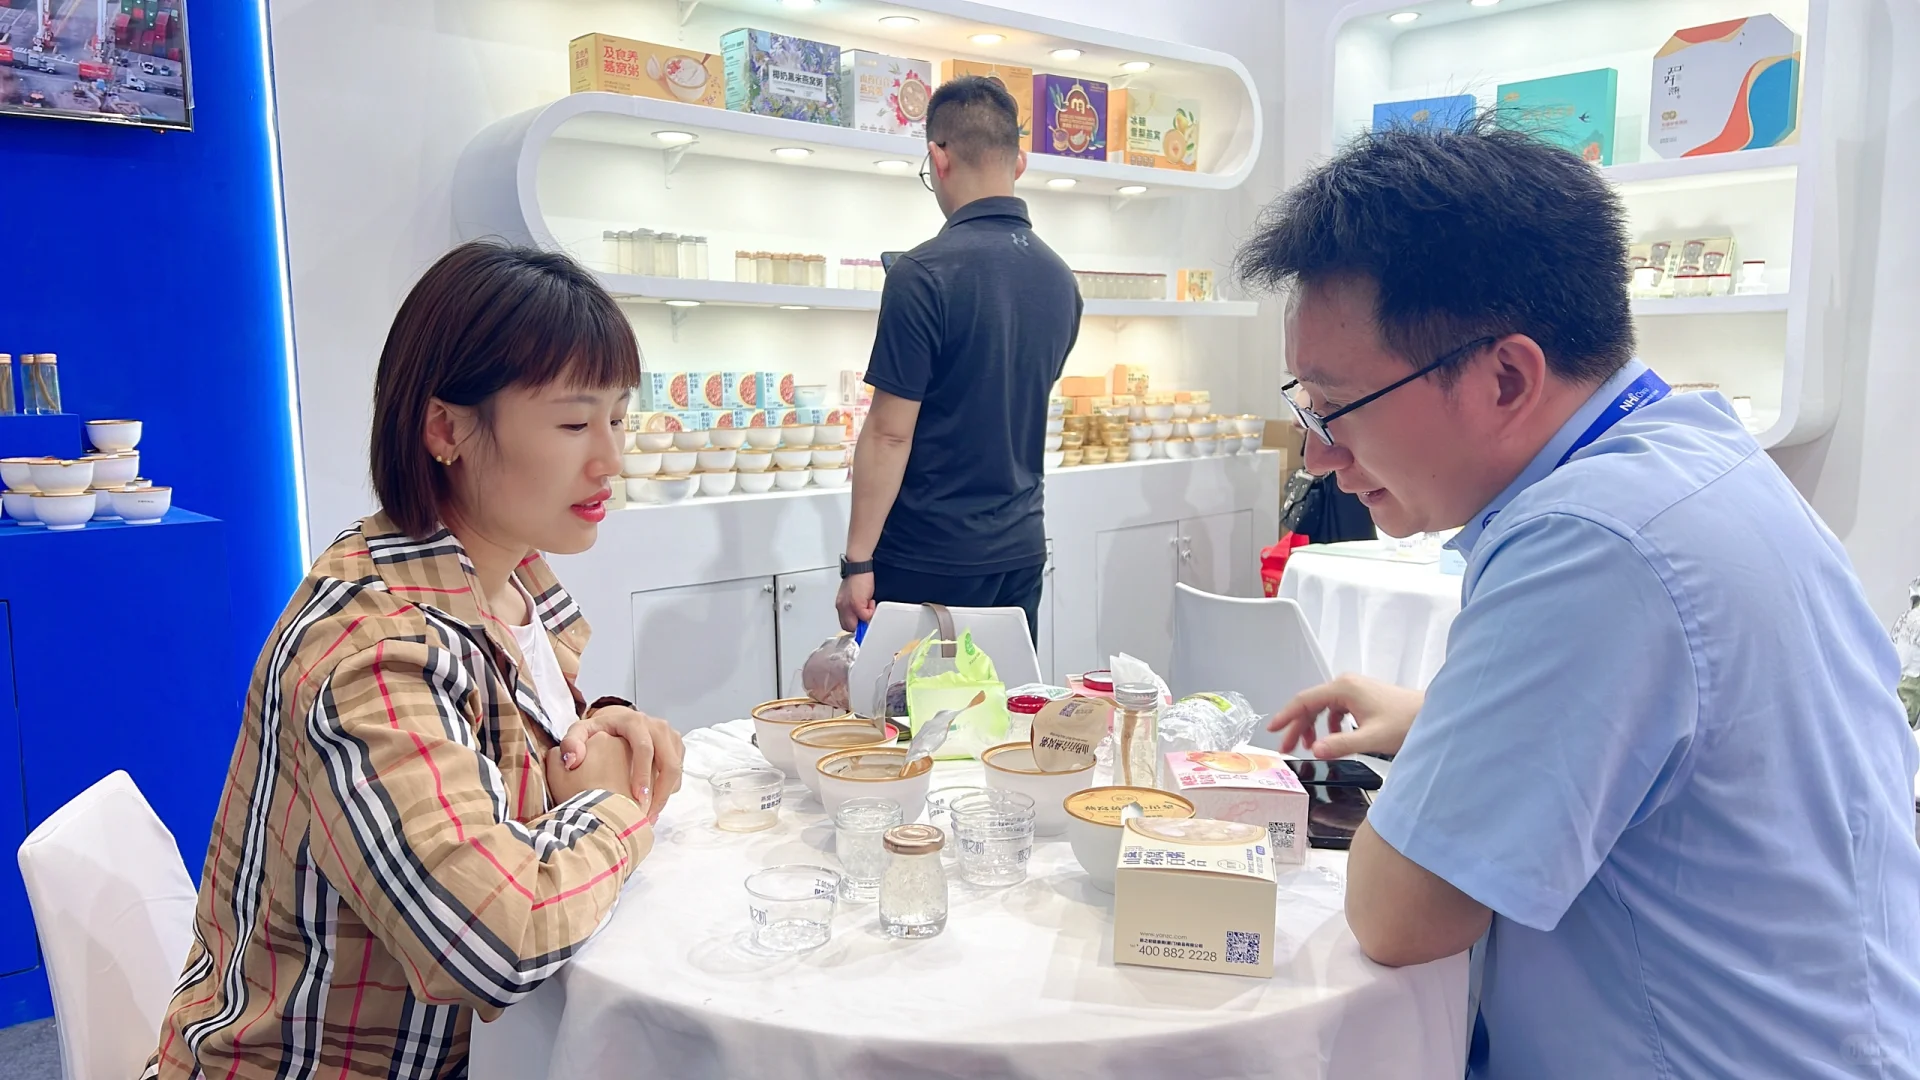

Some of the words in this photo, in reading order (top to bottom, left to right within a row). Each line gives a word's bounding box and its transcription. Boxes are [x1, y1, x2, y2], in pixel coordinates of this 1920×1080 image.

[603, 60, 640, 77] 燕窝粥
[772, 69, 824, 88] 椰奶黑米燕窝粥
[1138, 945, 1160, 957] 400
[1163, 947, 1185, 959] 882
[1188, 949, 1217, 962] 2228
